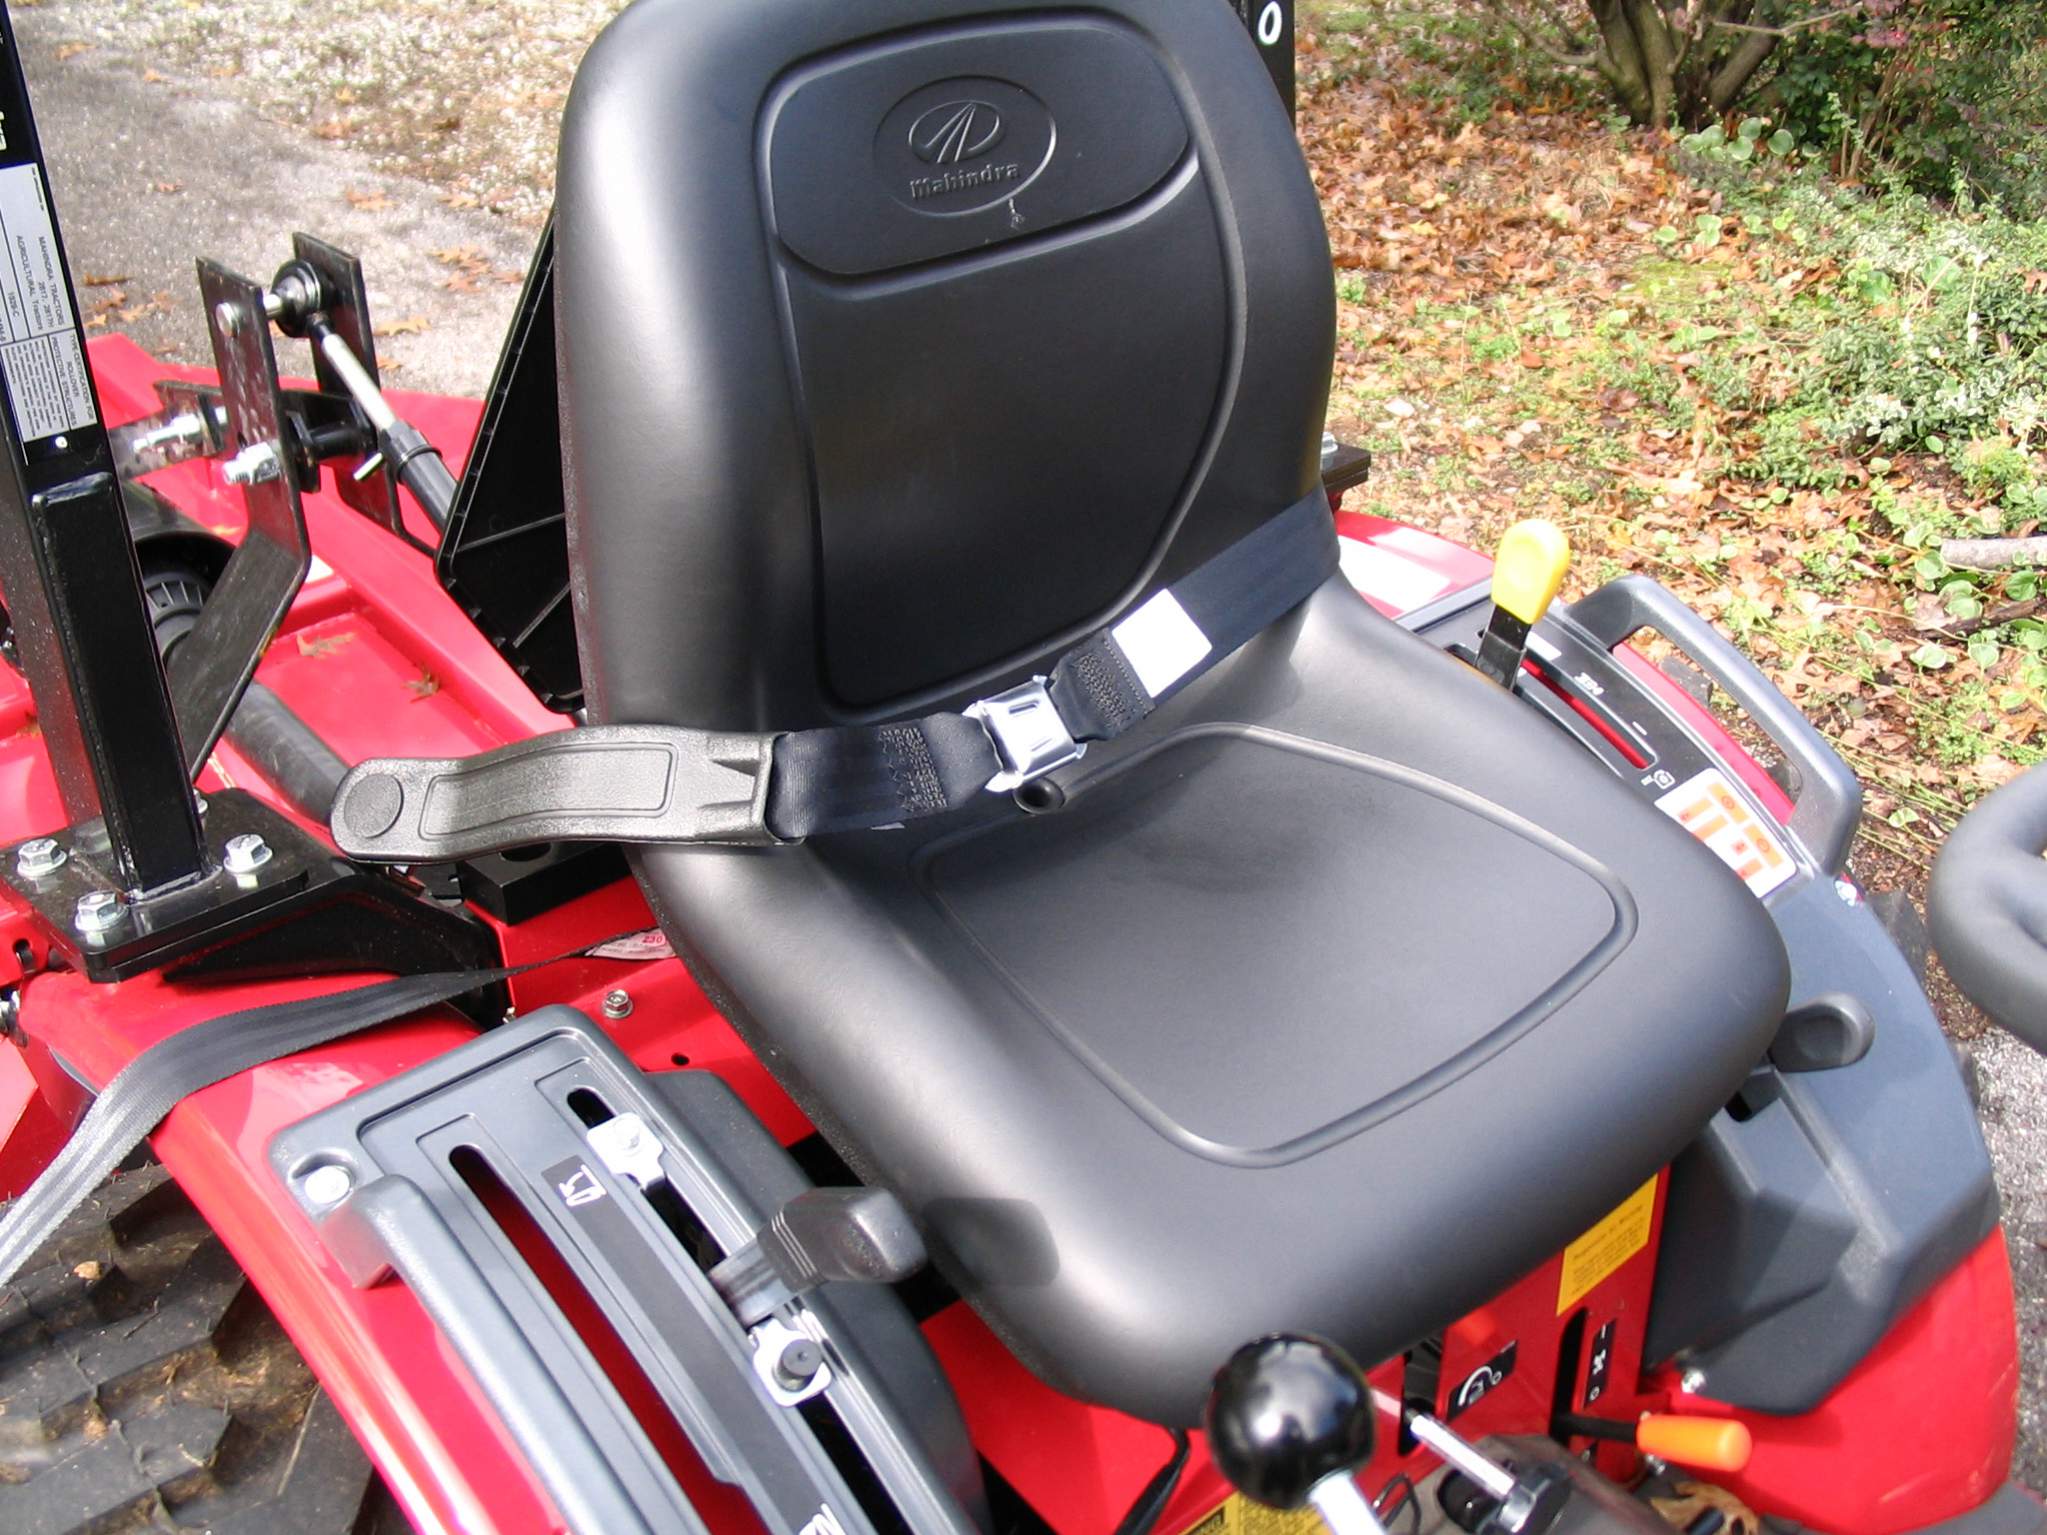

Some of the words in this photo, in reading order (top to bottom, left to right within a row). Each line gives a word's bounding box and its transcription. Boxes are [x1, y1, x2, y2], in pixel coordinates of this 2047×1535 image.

[910, 163, 1019, 198] Mahindra
[16, 235, 36, 296] AGRICULTURAL
[38, 237, 54, 280] MAHINDRA
[49, 284, 65, 325] TRACTORS
[65, 361, 79, 397] ROLLOVER
